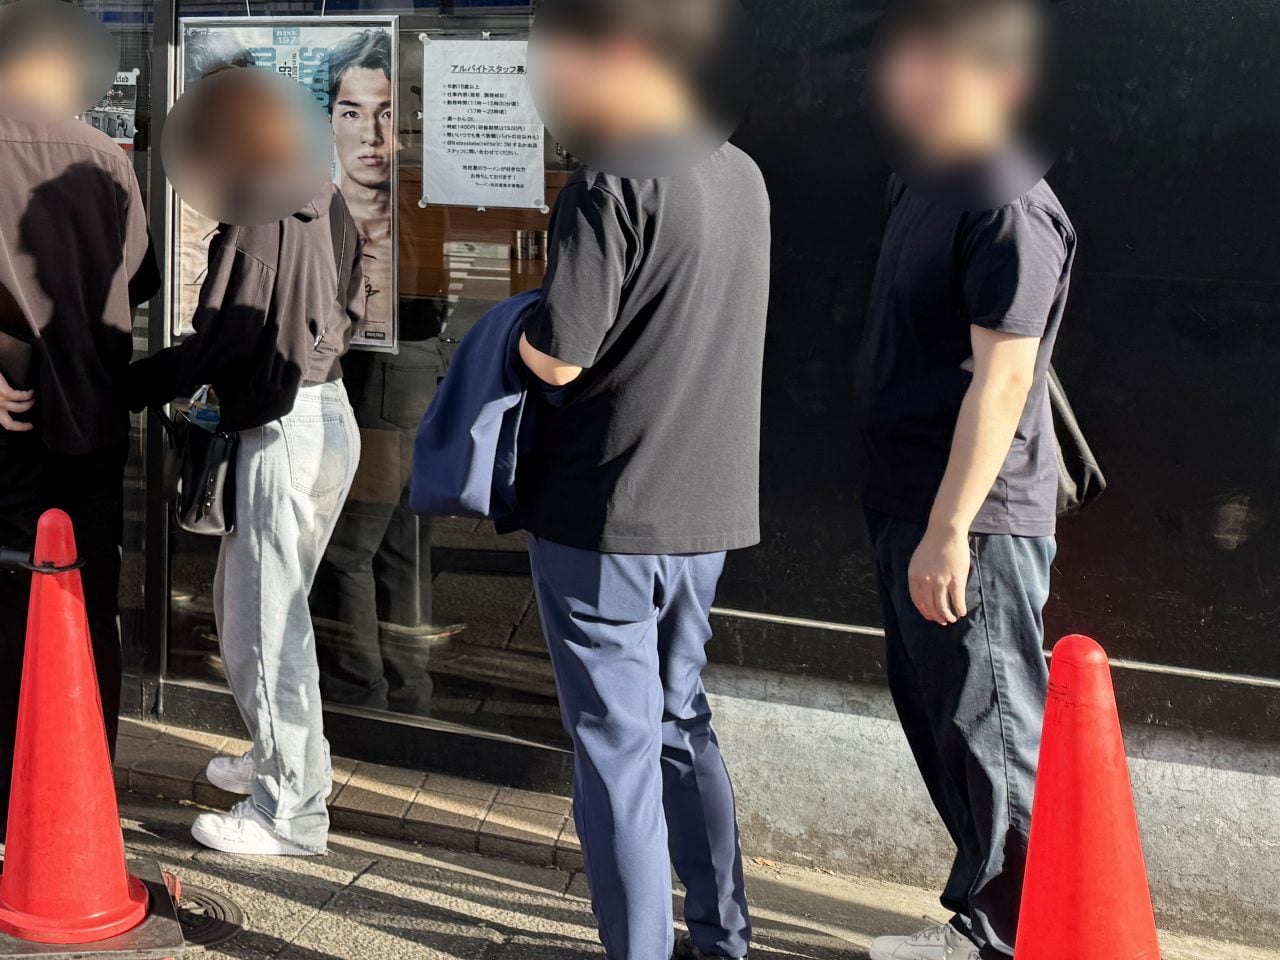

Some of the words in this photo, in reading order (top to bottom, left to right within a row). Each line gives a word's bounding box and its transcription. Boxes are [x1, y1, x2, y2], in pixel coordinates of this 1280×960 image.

[277, 36, 297, 44] 197
[450, 64, 527, 74] アルバイトスタッフ募
